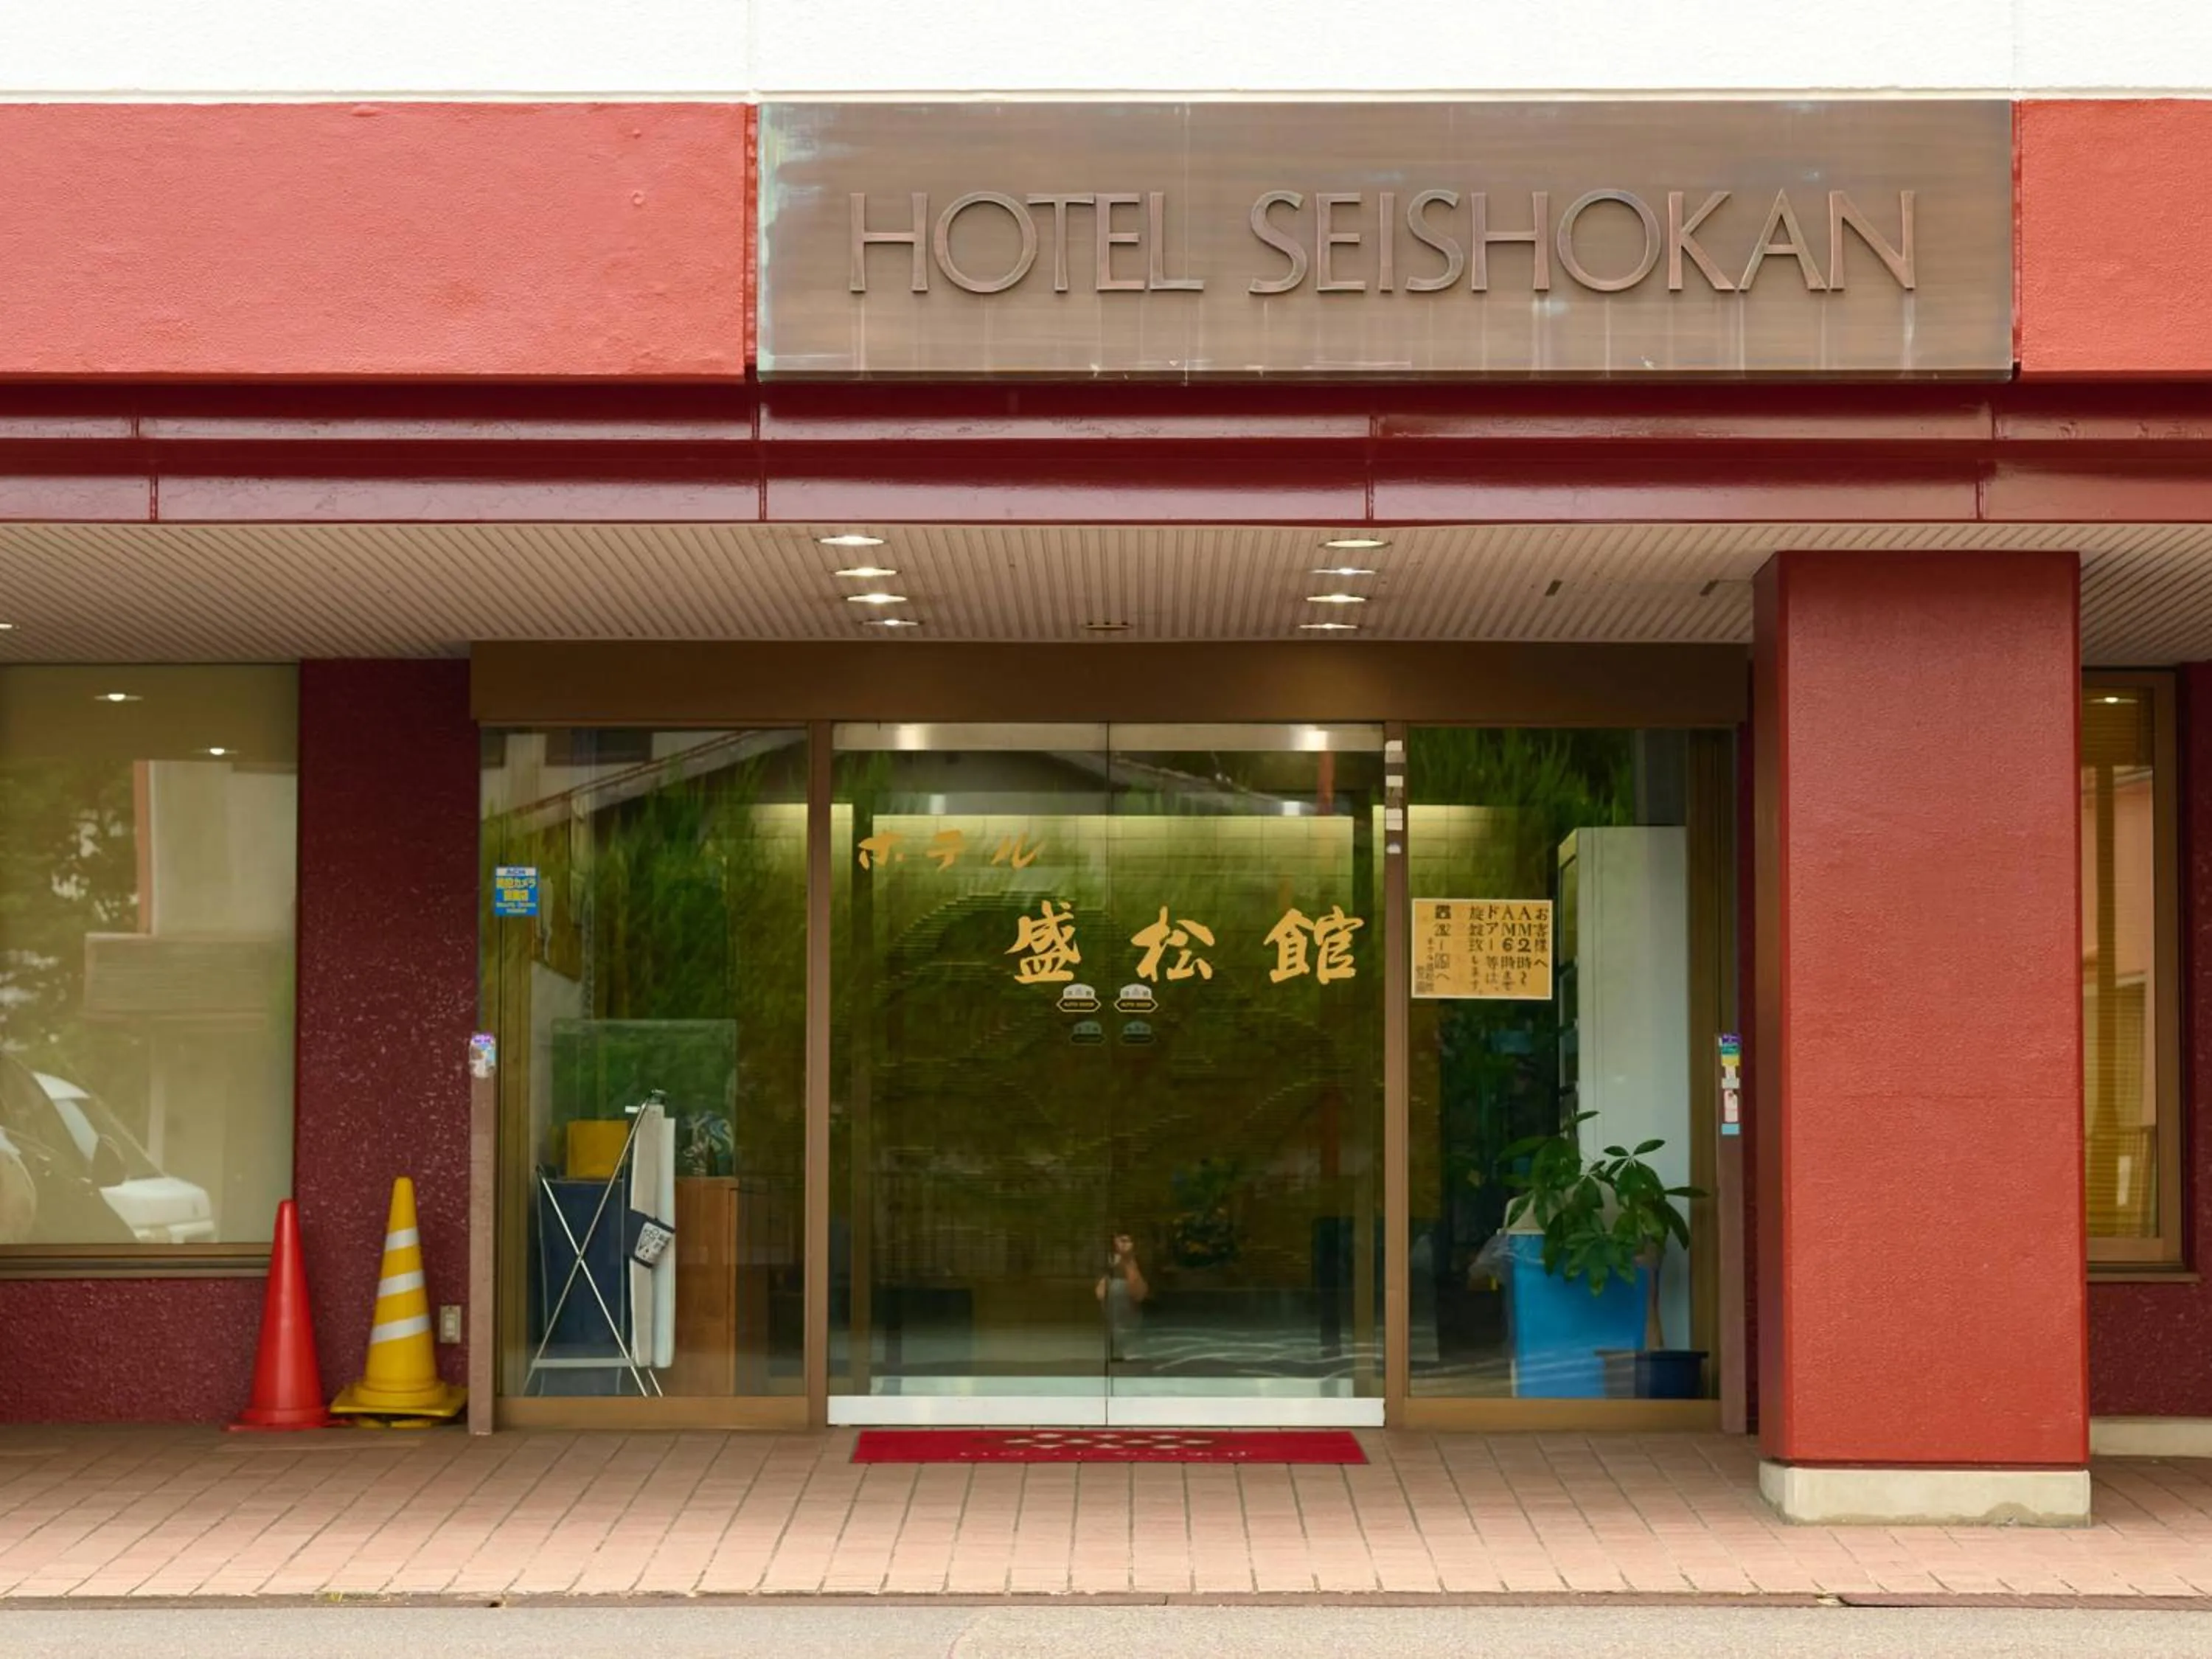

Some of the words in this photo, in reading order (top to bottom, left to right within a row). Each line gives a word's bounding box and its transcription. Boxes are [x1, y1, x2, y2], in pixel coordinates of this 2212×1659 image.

[848, 189, 1204, 295] HOTEL
[1249, 188, 1916, 295] SEISHOKAN
[858, 830, 1041, 870] ホテル
[1004, 900, 1364, 984] 盛松館
[1534, 907, 1548, 967] お客様へ
